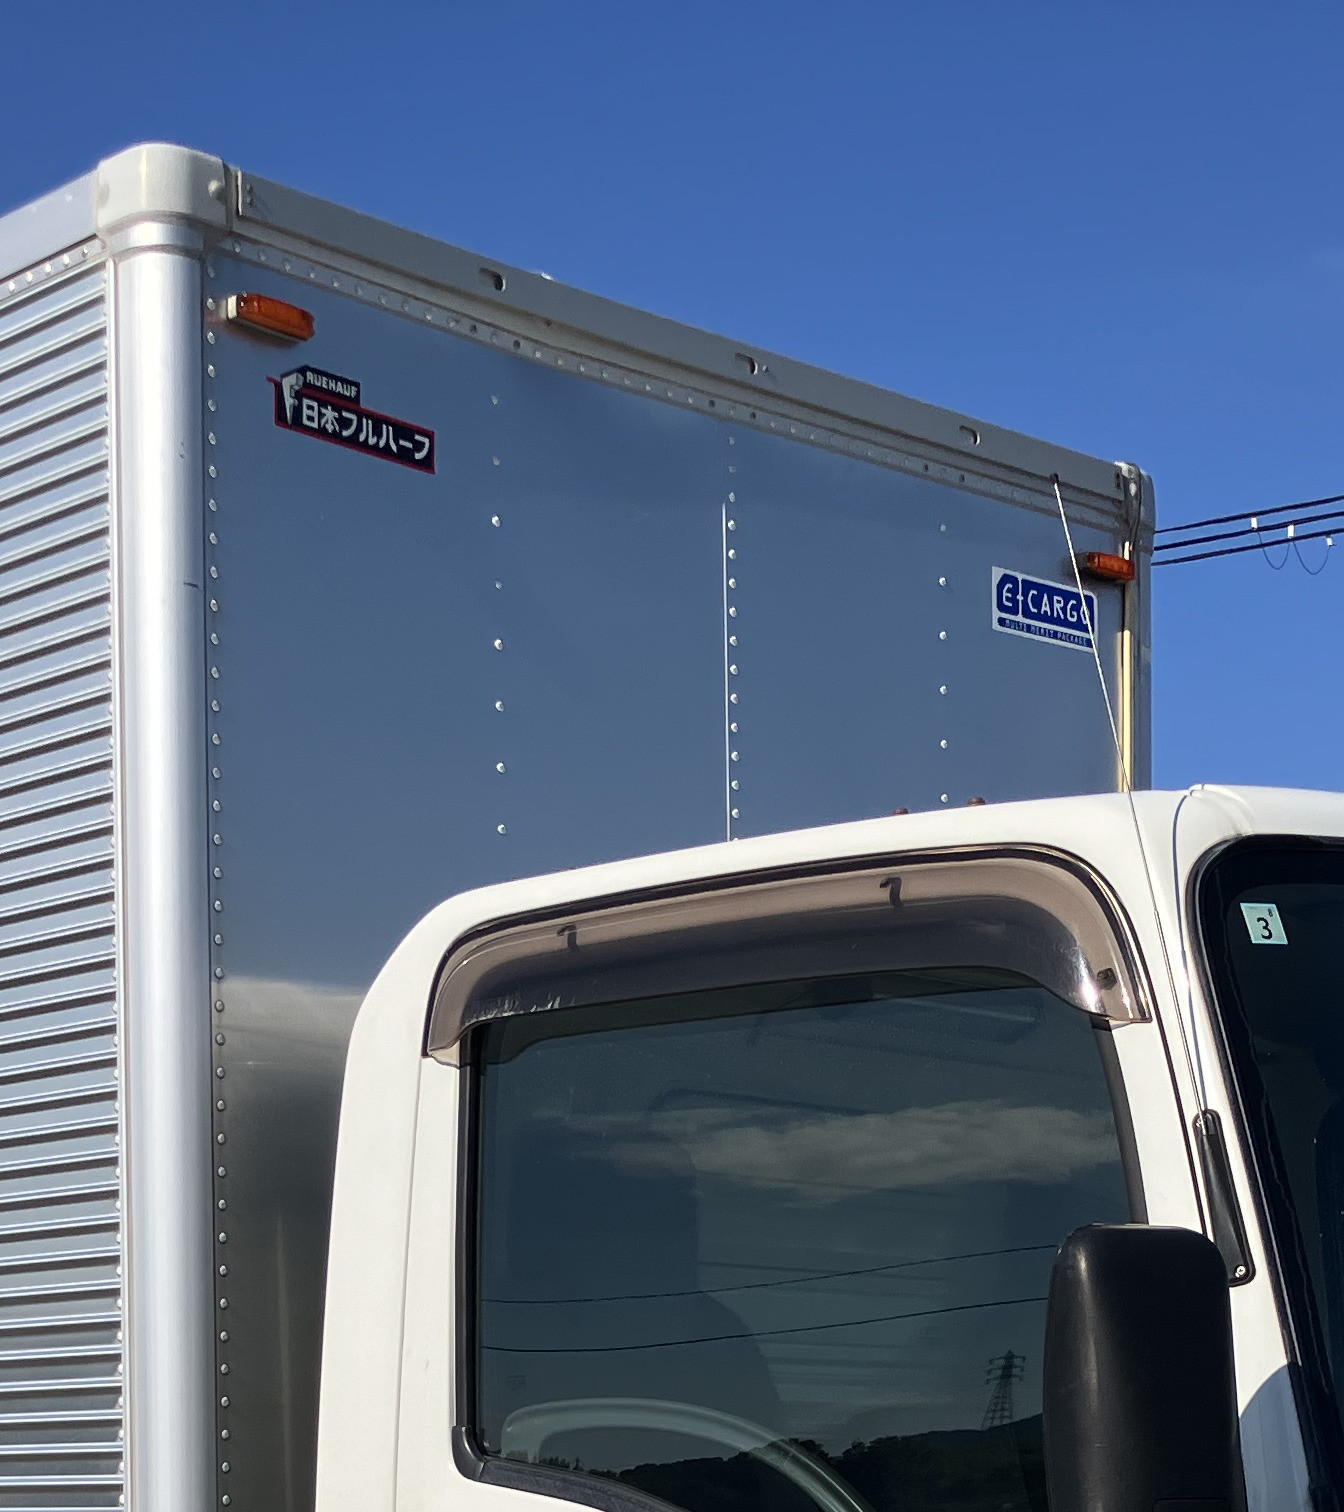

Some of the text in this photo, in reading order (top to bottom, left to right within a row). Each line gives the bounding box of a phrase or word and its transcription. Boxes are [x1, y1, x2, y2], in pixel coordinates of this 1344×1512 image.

[302, 398, 430, 460] 日本フルハーフ
[1256, 917, 1273, 940] 3
